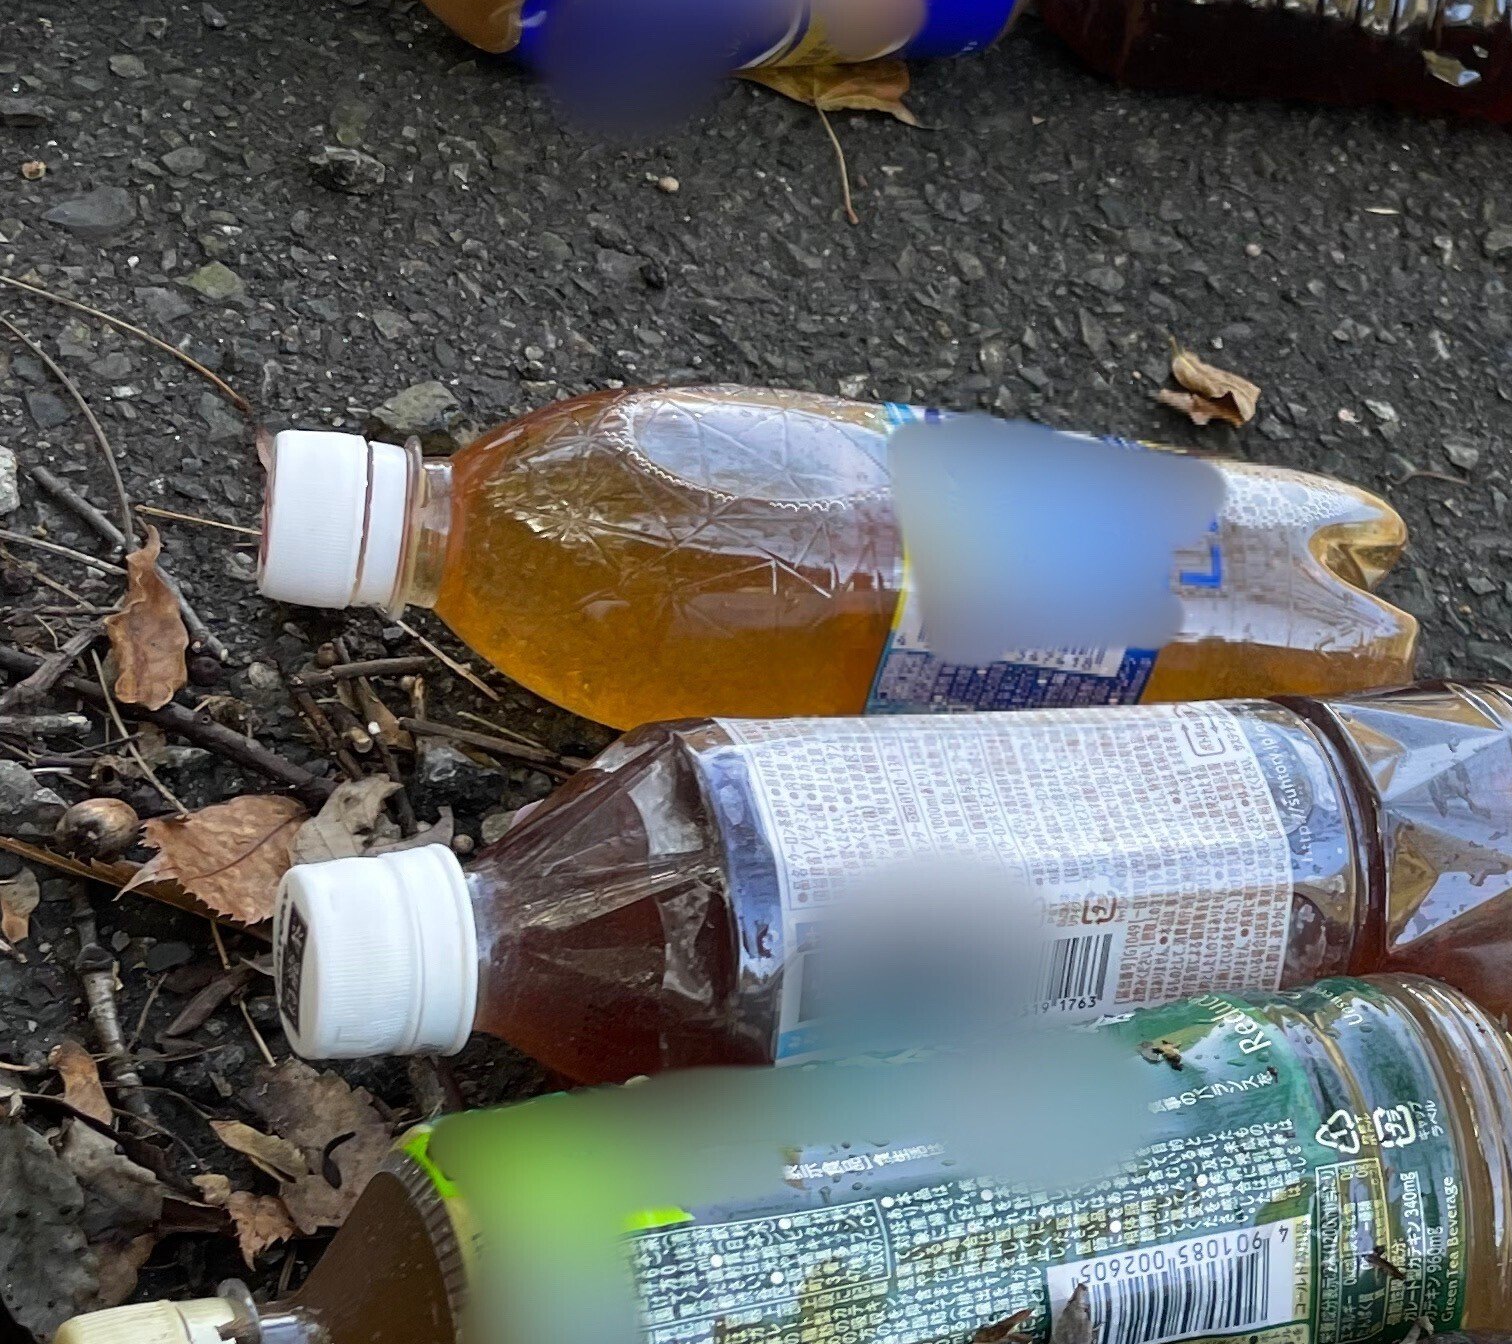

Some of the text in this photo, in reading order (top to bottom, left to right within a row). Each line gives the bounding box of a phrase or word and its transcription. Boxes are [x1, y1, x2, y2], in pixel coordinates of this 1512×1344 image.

[1058, 996, 1098, 1012] 1763
[1384, 1108, 1406, 1138] プラ
[1407, 1099, 1428, 1142] キャップ
[1425, 1099, 1445, 1138] ラベル
[1399, 1170, 1420, 1218] 340mg
[1079, 1224, 1289, 1284] 4 901085 002605
[1426, 1225, 1444, 1273] 960mg
[1440, 1175, 1461, 1323] Green Tea Beverage
